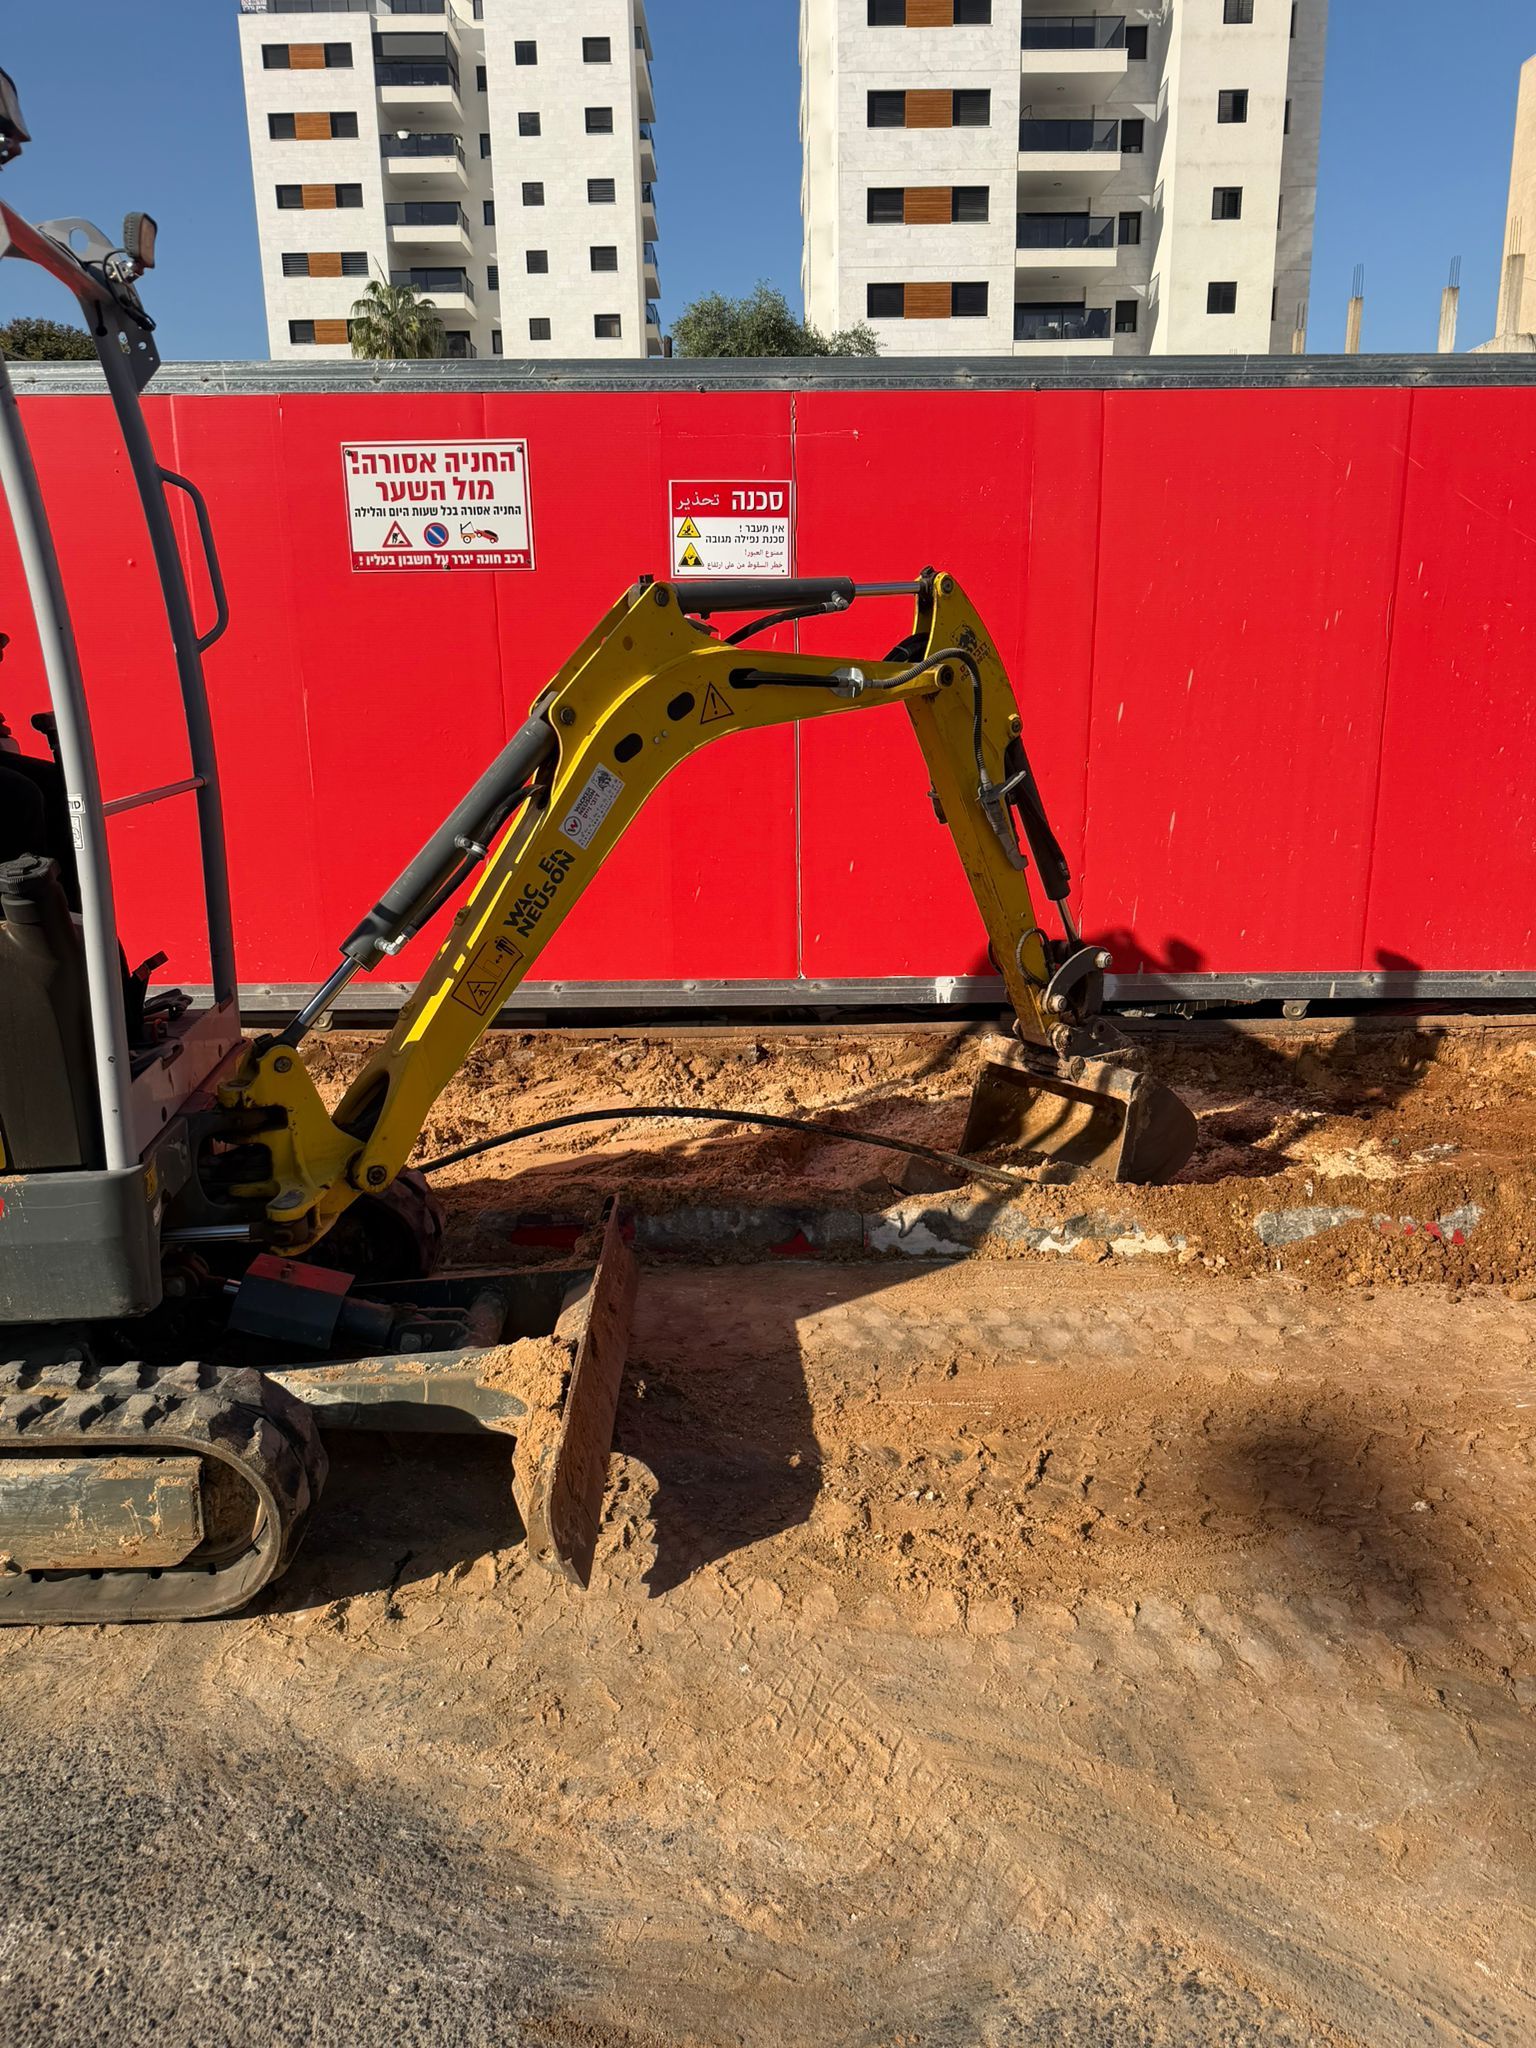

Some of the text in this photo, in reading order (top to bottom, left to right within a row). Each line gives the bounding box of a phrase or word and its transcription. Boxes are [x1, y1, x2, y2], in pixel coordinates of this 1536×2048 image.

[444, 452, 515, 472] החניה
[375, 476, 495, 502] מול השער
[676, 492, 720, 510] تحذير
[731, 491, 783, 510] סכנה
[354, 505, 521, 517] החניה אסורה בכל שעות היום והלילה
[745, 524, 769, 533] מעבר
[772, 525, 785, 534] אין
[705, 534, 785, 543] סכנת נפילה מגובה
[366, 554, 396, 566] בעליו
[398, 554, 432, 567] חשבון
[434, 553, 449, 567] על
[451, 554, 474, 565] יגרר
[476, 554, 502, 565] חונה
[504, 553, 524, 564] רכב
[516, 851, 576, 937] NEUSON
